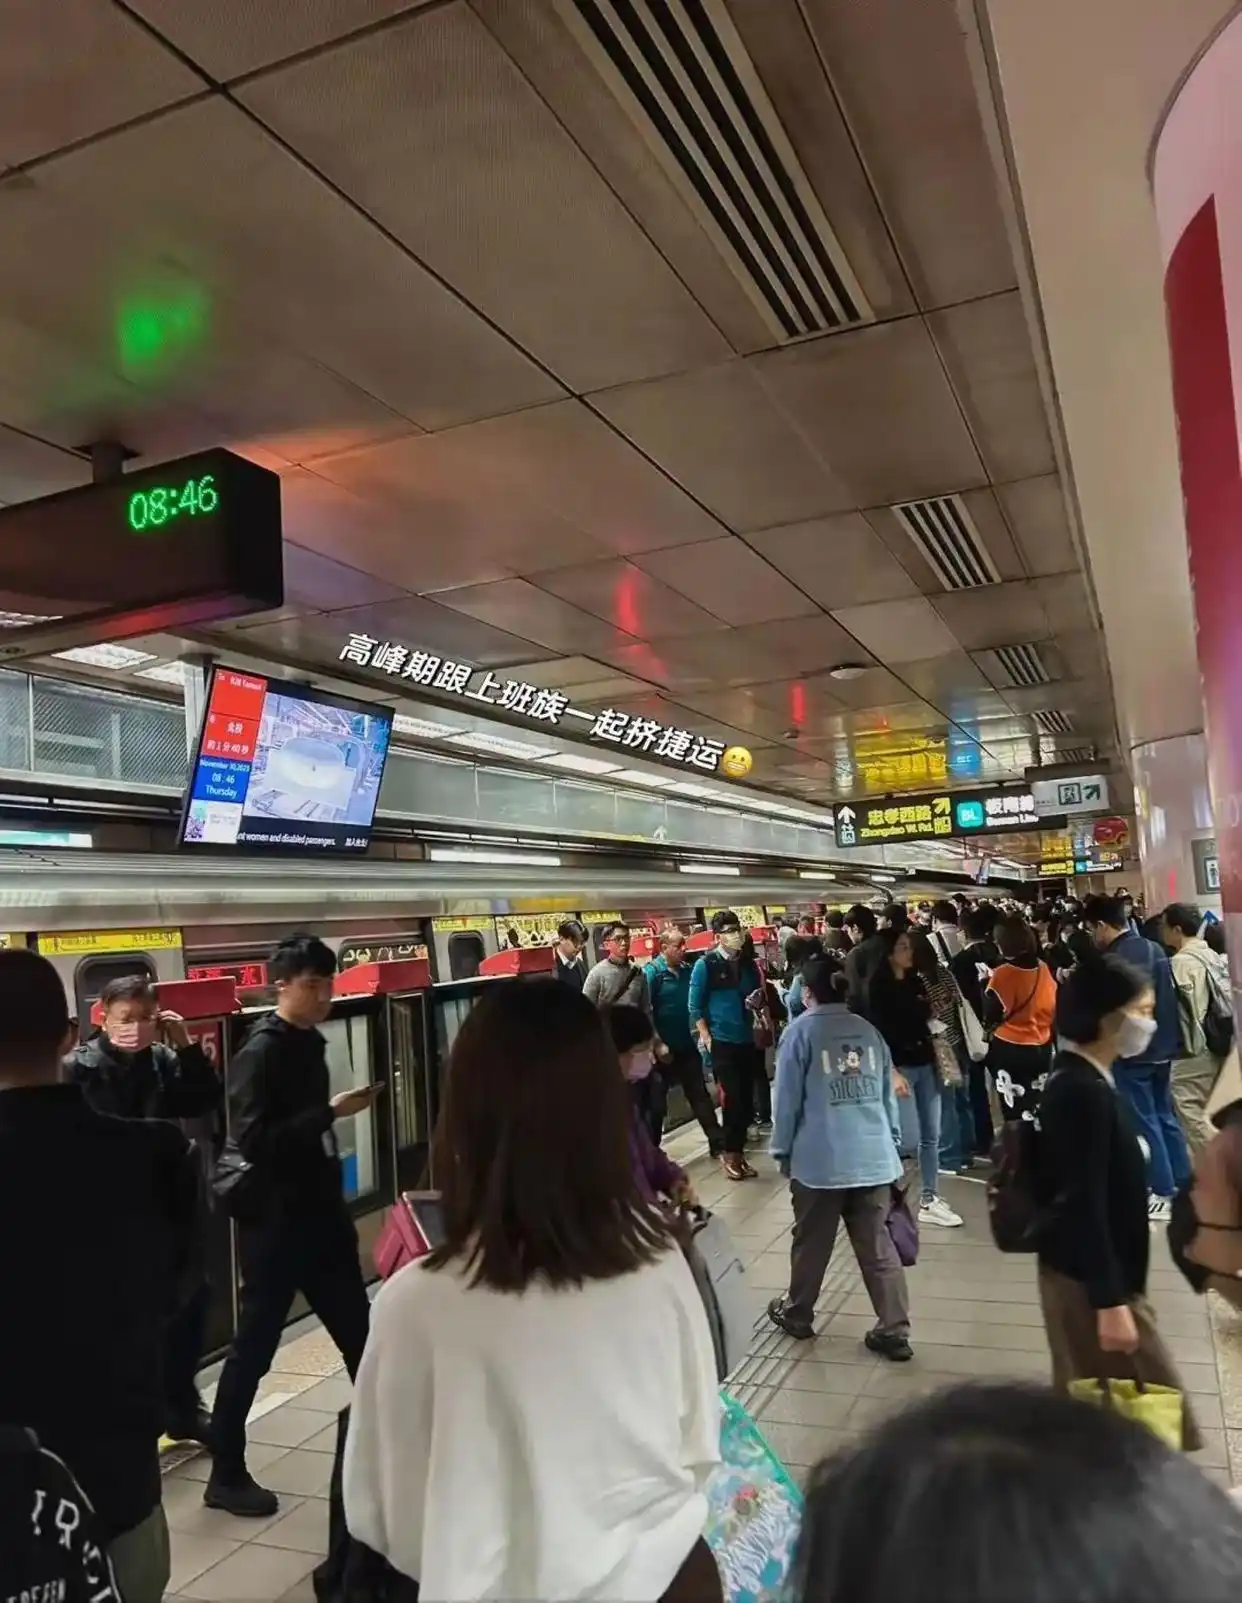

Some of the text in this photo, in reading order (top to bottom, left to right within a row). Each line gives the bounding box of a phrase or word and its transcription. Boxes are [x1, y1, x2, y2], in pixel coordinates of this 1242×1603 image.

[128, 475, 218, 531] 08:46
[200, 759, 229, 770] November
[205, 784, 239, 799] Thursday
[269, 833, 282, 842] and
